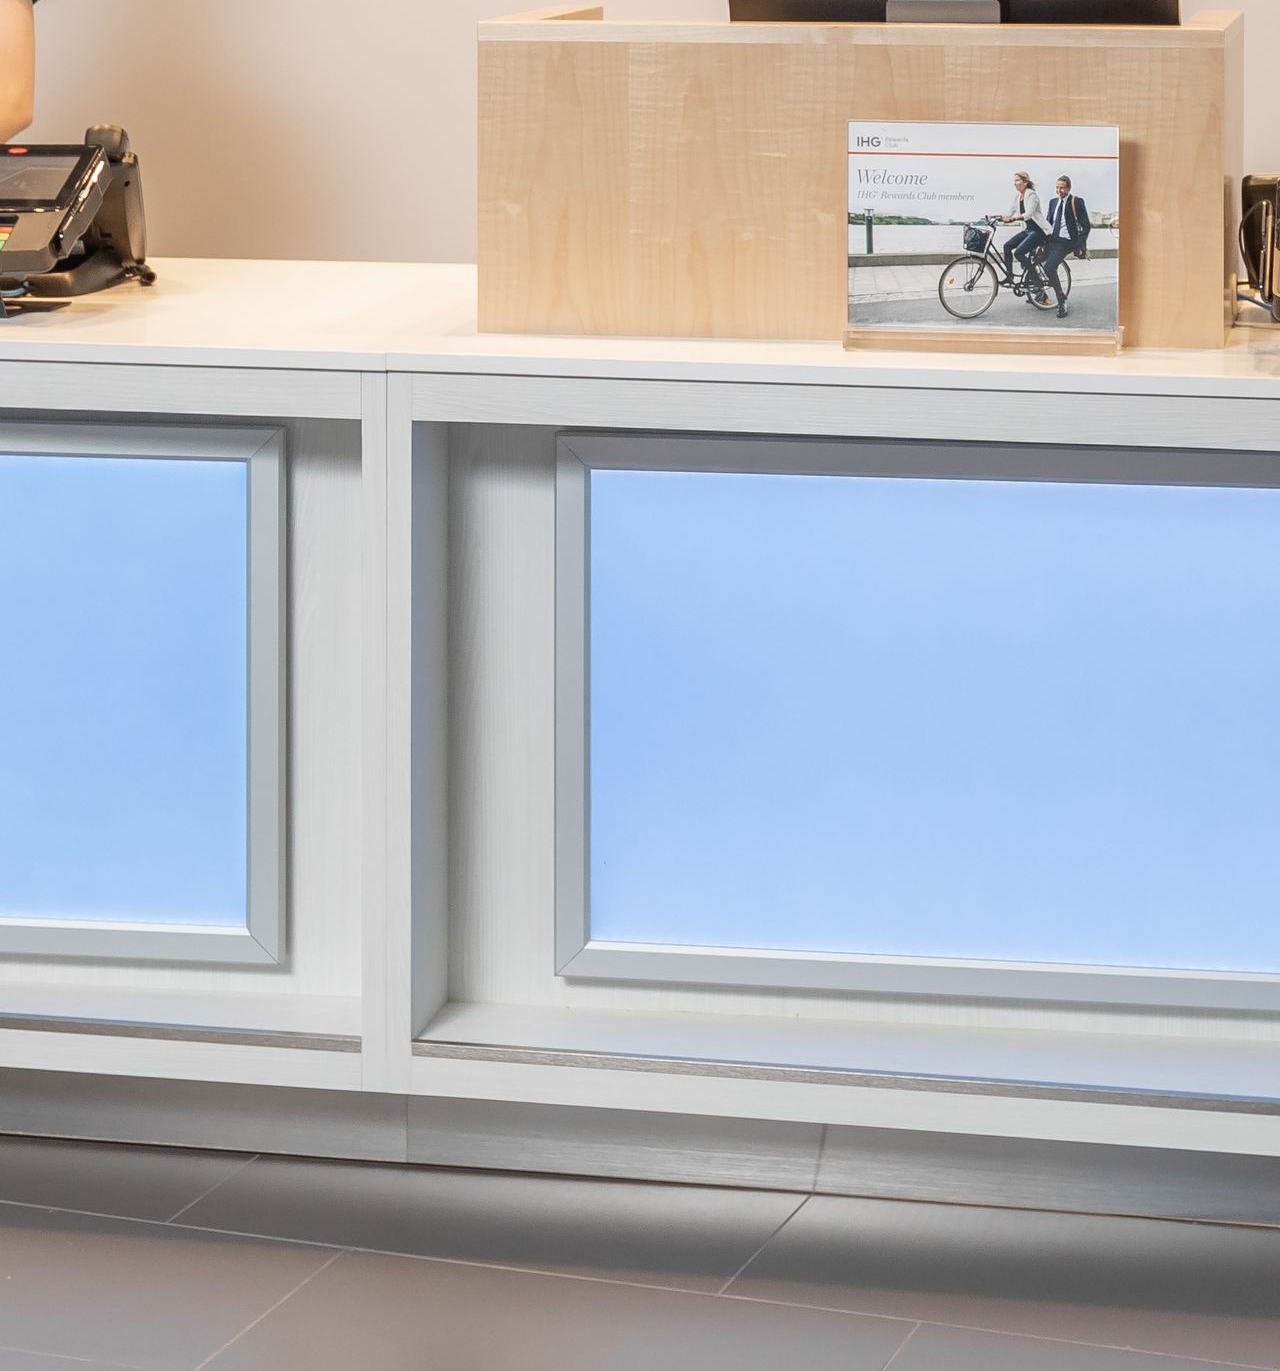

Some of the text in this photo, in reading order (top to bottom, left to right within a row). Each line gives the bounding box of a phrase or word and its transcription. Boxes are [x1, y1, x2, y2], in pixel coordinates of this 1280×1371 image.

[856, 136, 882, 148] IHG
[856, 169, 929, 186] Welcome
[880, 190, 916, 201] Rewards
[916, 191, 937, 202] Club
[937, 191, 976, 202] members
